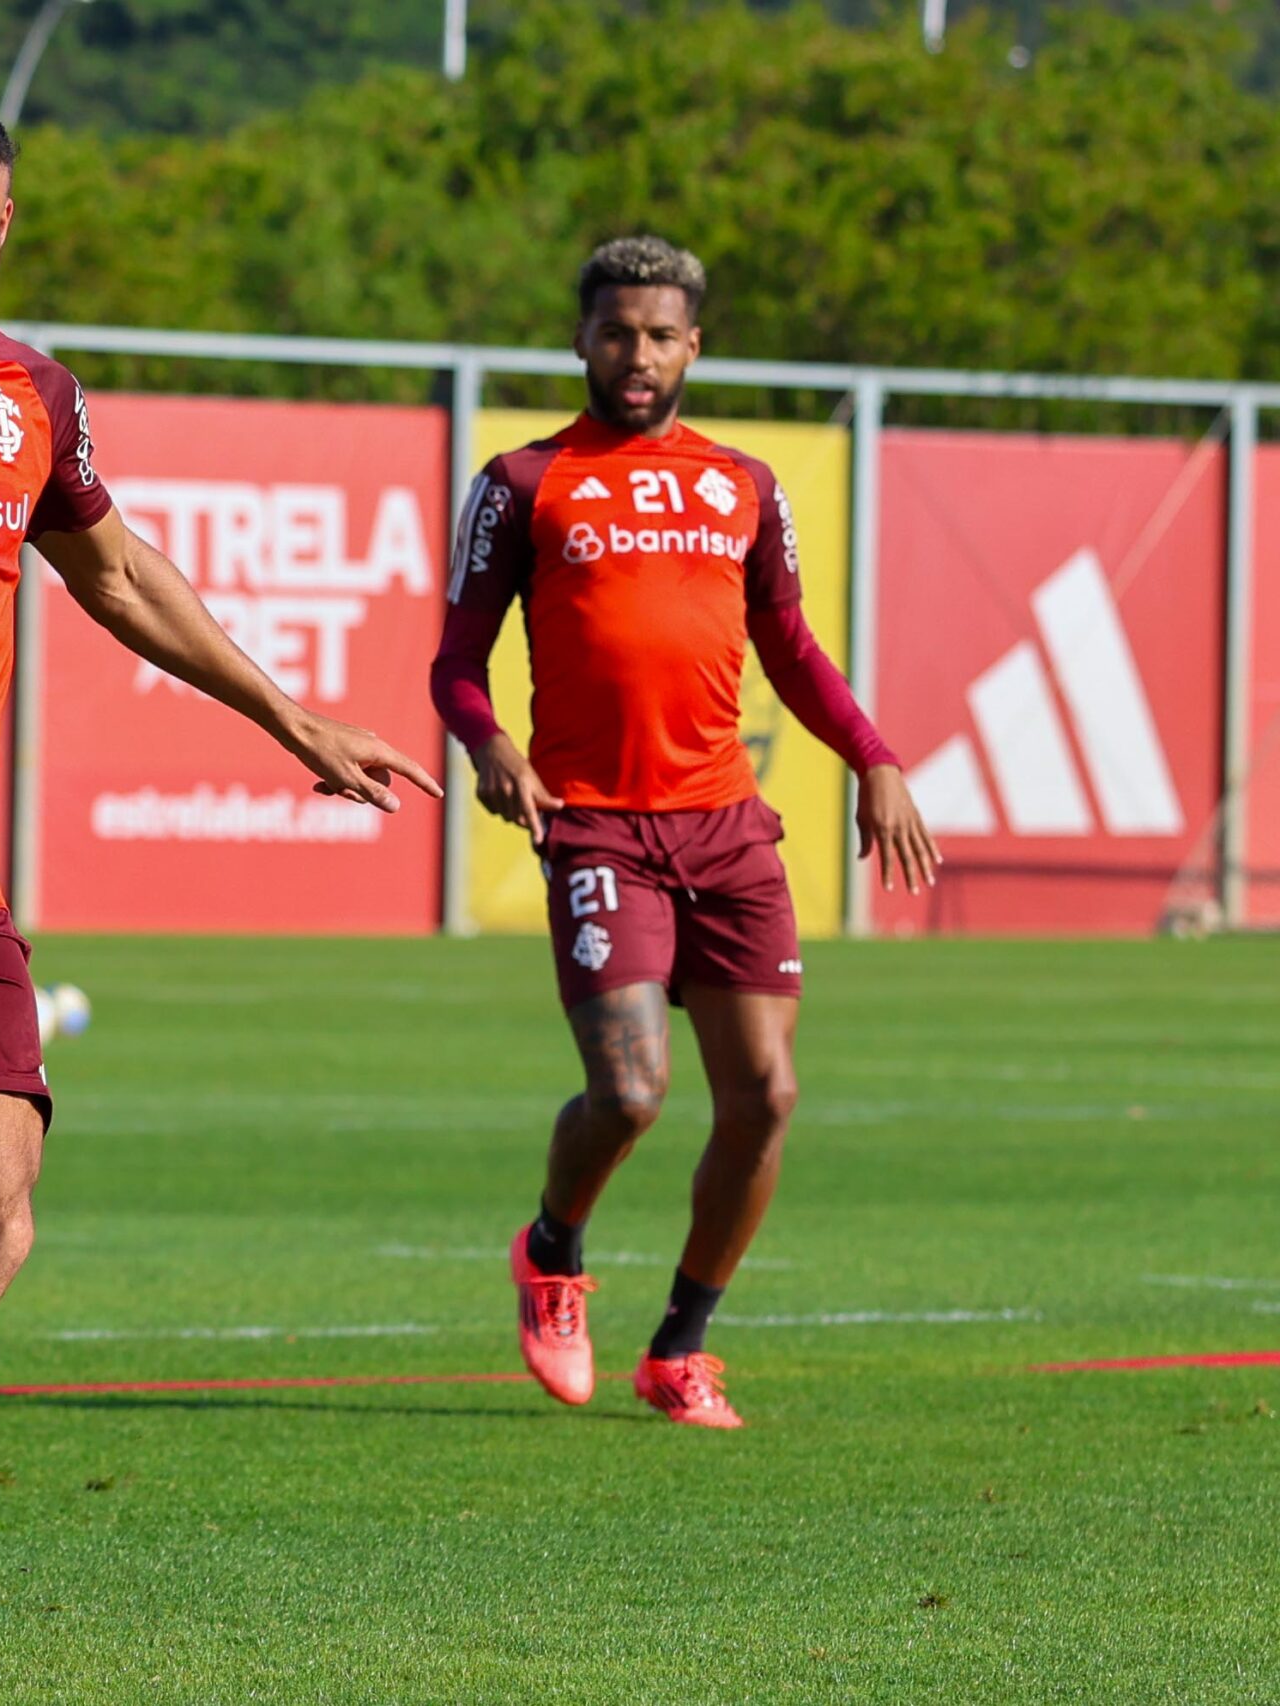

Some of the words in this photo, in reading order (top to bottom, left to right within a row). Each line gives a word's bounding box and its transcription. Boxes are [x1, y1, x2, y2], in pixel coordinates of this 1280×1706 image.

[628, 469, 685, 514] 21
[470, 506, 499, 573] vero
[609, 523, 749, 562] banrisul
[569, 866, 618, 918] 21
